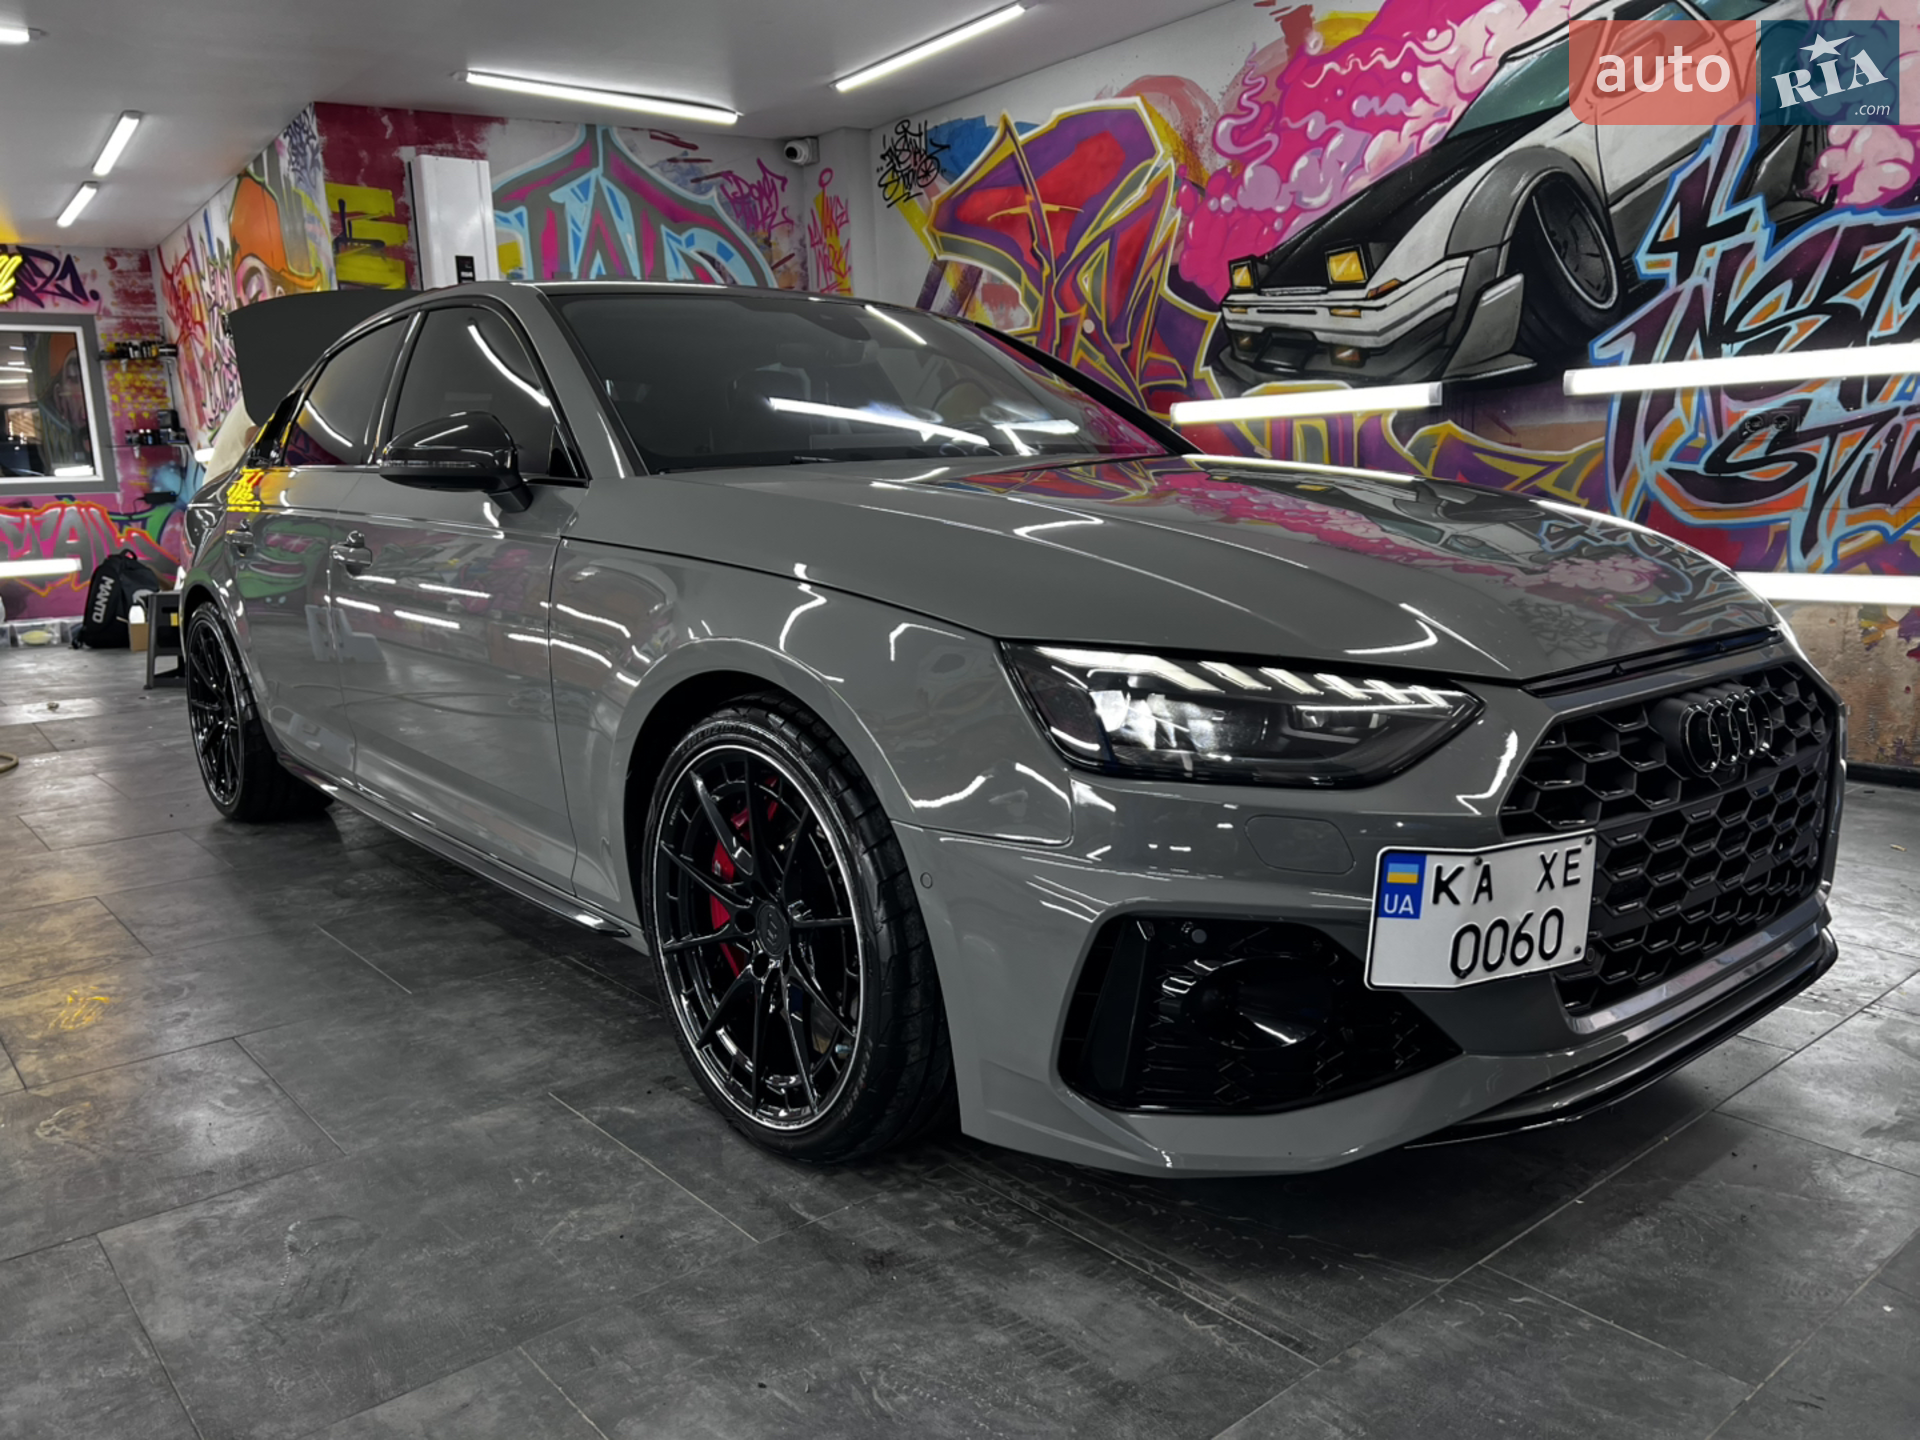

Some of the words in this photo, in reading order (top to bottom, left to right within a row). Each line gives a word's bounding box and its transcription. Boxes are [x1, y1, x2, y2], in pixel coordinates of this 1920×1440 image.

[92, 575, 115, 623] MANTO
[1431, 861, 1494, 906] KA
[1536, 847, 1582, 893] XE
[1383, 893, 1415, 915] UA
[1449, 906, 1565, 980] 0060
